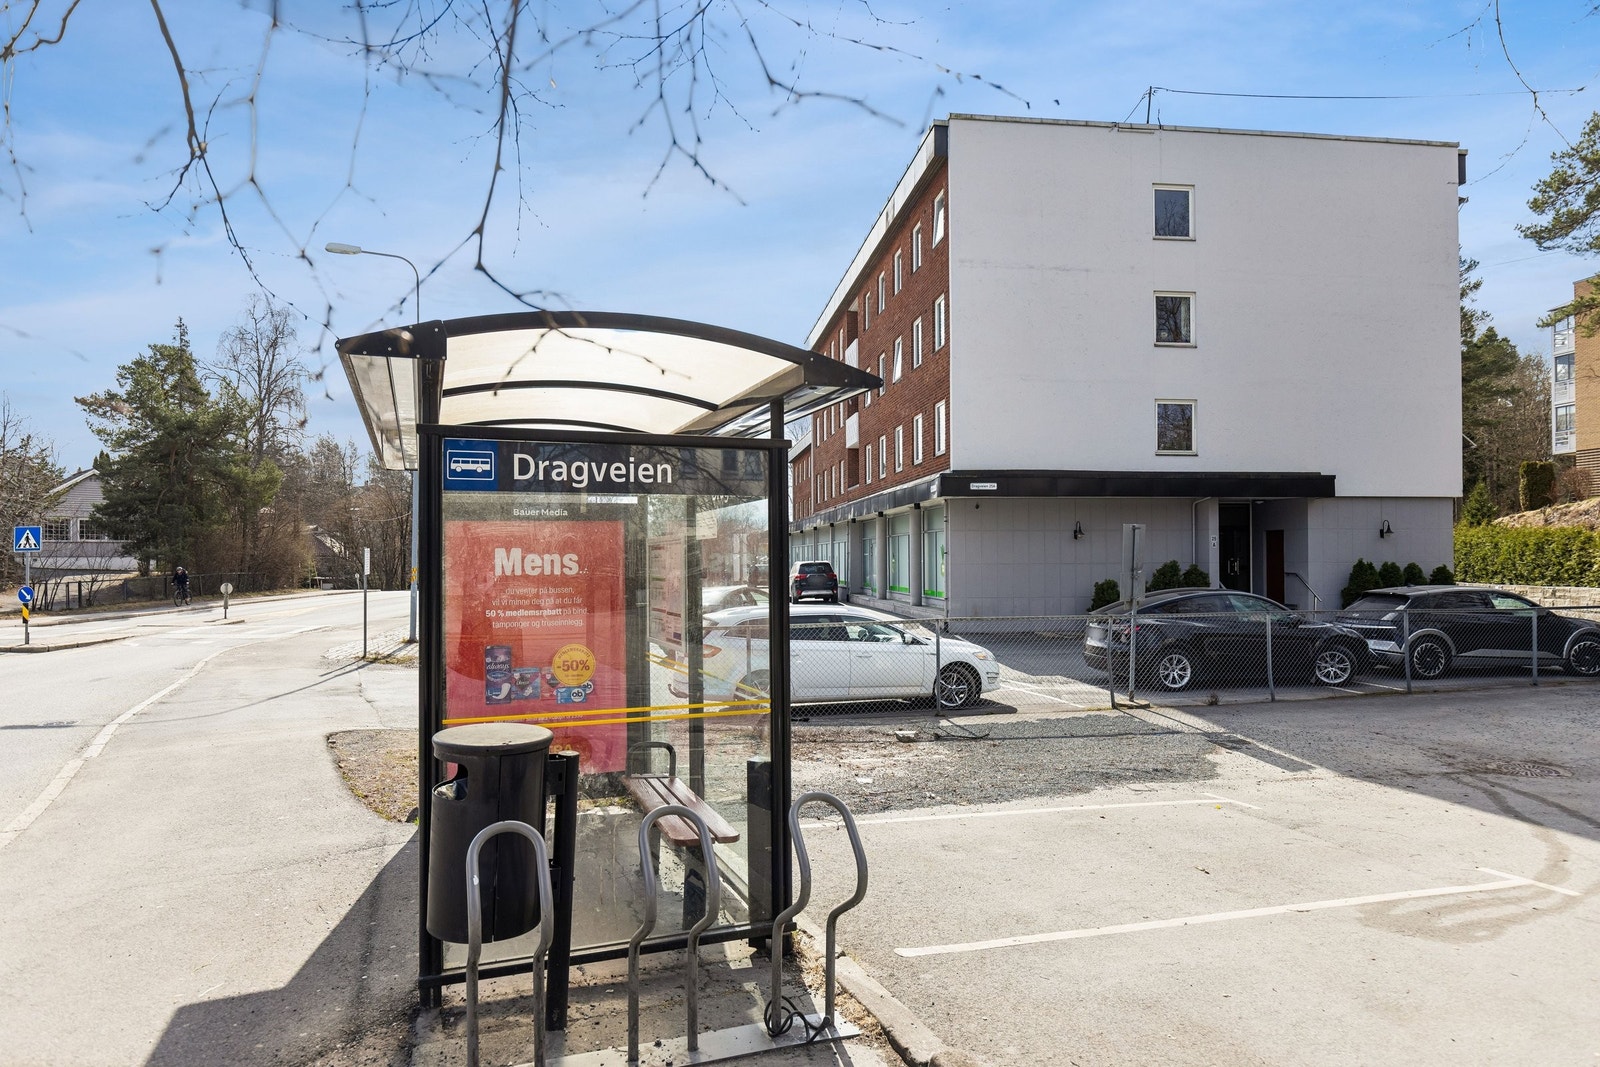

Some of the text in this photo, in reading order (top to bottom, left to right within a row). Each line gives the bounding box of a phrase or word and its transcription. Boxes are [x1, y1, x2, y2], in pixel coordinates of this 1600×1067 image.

[513, 453, 673, 488] Dragveien
[513, 508, 568, 516] Bauer Media
[539, 586, 548, 595] på
[531, 598, 544, 607] deg
[545, 597, 554, 606] på
[485, 610, 496, 618] 50
[498, 609, 505, 617] %
[505, 608, 562, 617] medlemsrabatt
[563, 607, 572, 617] på
[492, 620, 530, 629] tamponger
[556, 659, 590, 672] -50%
